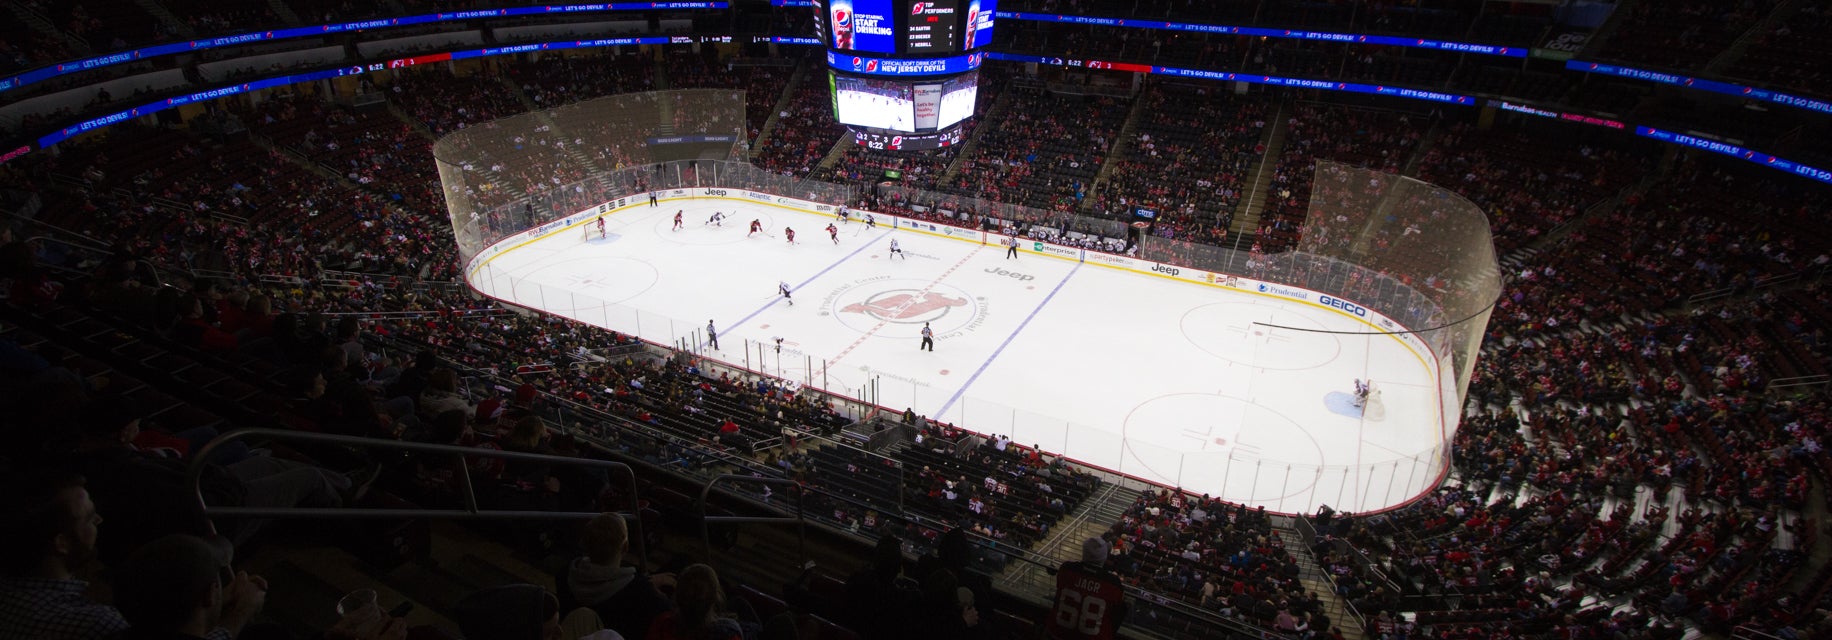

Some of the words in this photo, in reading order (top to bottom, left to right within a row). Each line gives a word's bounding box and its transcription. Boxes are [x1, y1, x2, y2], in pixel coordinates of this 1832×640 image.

[345, 22, 360, 30] LET'S
[369, 19, 389, 27] DEVILS!
[855, 19, 878, 27] START
[856, 26, 892, 35] DRINKING
[1332, 33, 1355, 41] DEVILS!
[214, 38, 229, 46] LET'S
[239, 33, 261, 42] DEVILS!
[1441, 41, 1458, 49] LET'S
[1469, 44, 1494, 52] DEVILS!
[83, 59, 99, 68] LET'S
[99, 57, 109, 65] GO
[109, 53, 130, 63] DEVILS!
[897, 65, 923, 74] JERSEY
[923, 64, 946, 72] DEVILS
[1180, 69, 1195, 77] LET'S
[1619, 67, 1638, 77] LET'S
[1639, 70, 1651, 79] GO
[1651, 72, 1678, 83] DEVILS!
[1285, 78, 1301, 86] LET'S
[1311, 80, 1334, 88] DEVILS!
[191, 93, 208, 101] LET'S
[218, 86, 239, 96] DEVILS!
[1400, 89, 1417, 97] LET'S
[1417, 90, 1428, 98] GO
[1428, 92, 1453, 101] DEVILS!
[1773, 93, 1794, 104] LET'S
[1794, 97, 1807, 106] GO
[80, 120, 97, 130] LET'S
[96, 117, 107, 126] GO
[107, 111, 128, 124] DEVILS!
[868, 141, 884, 150] 6:22
[1675, 134, 1695, 145] LET'S
[1696, 139, 1709, 148] GO
[1709, 142, 1740, 155] DEVILS!
[1796, 165, 1818, 177] LET'S
[1818, 171, 1832, 180] GO
[704, 187, 727, 198] Jeep
[749, 191, 771, 201] Atlantic
[984, 267, 1035, 281] Jeep
[1151, 263, 1179, 276] Jeep
[1270, 285, 1308, 299] Prudential
[1319, 295, 1366, 317] GEICO
[1074, 577, 1101, 593] JAGR
[1055, 588, 1106, 636] 68
